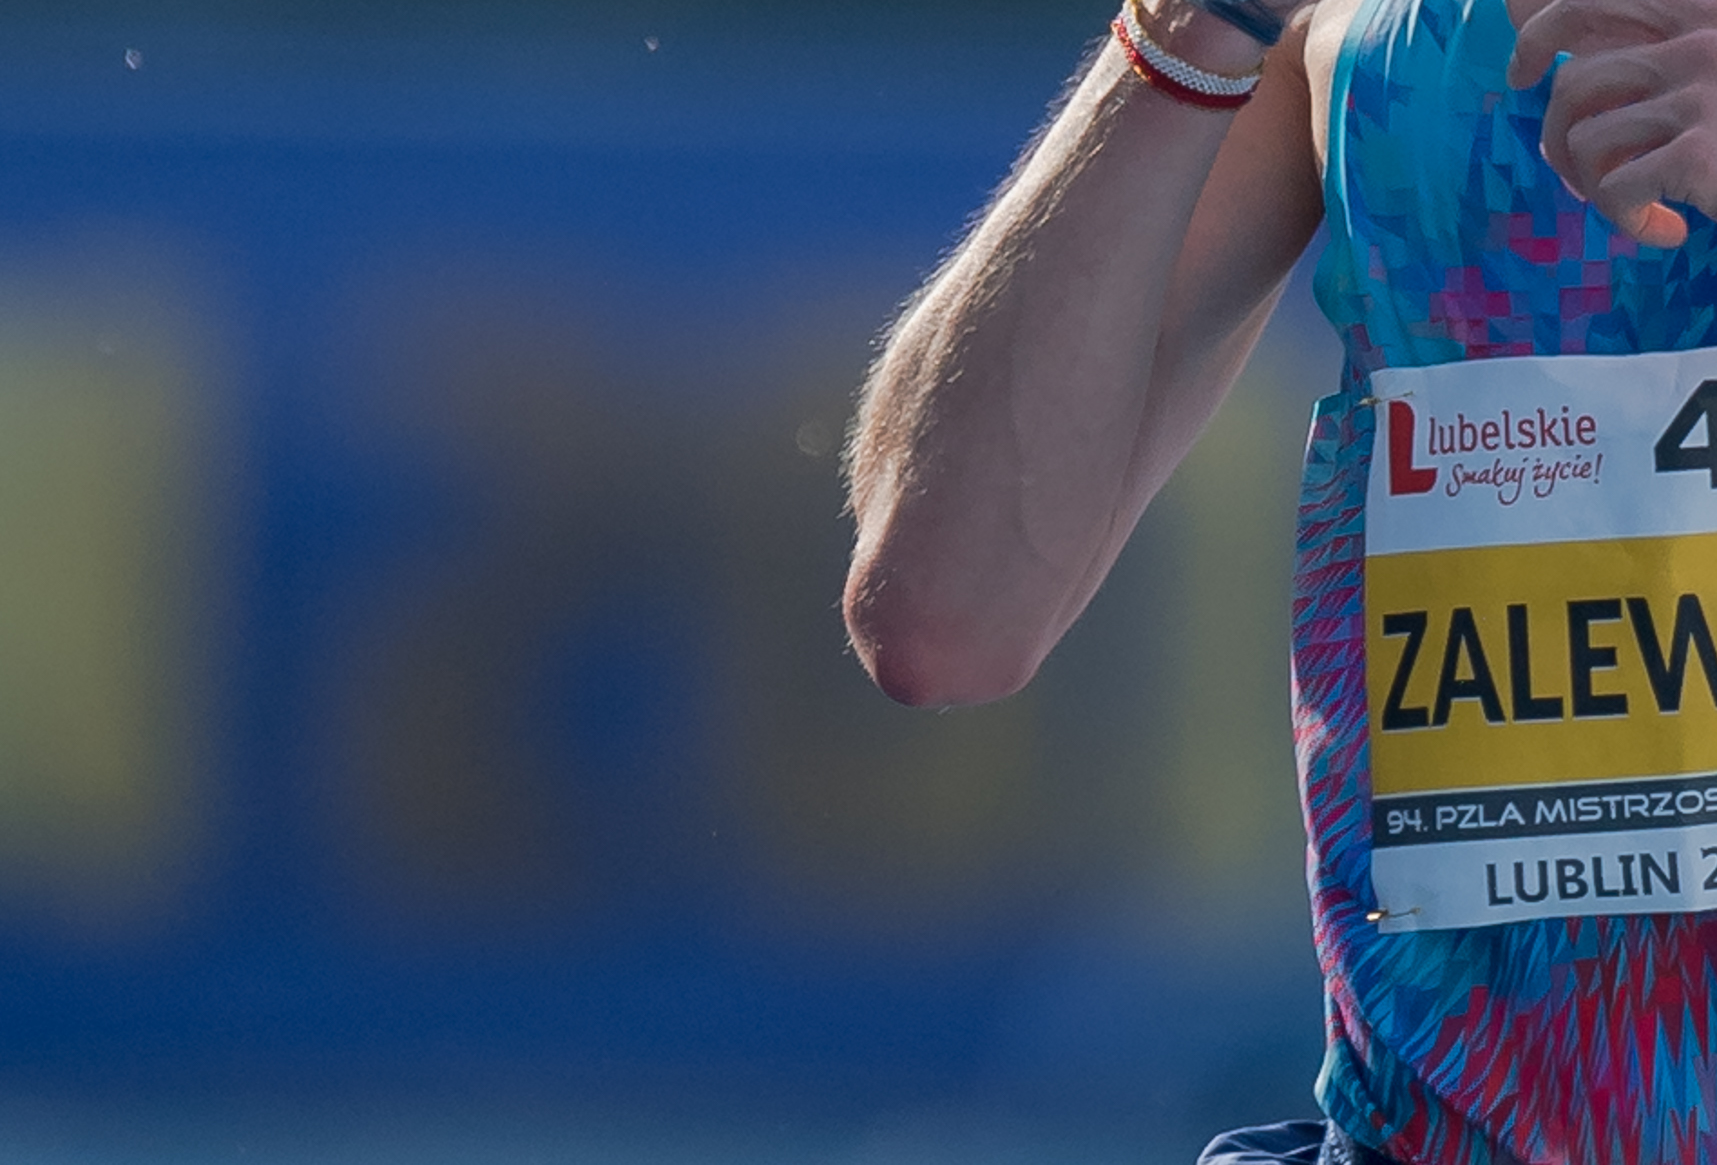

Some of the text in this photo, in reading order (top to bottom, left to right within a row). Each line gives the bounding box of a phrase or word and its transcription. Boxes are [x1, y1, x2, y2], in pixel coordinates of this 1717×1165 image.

[1446, 452, 1604, 506] Smakuj życie!
[1387, 808, 1429, 834] 94.
[1435, 801, 1526, 831] PZLA
[1485, 850, 1682, 907] LUBLIN
